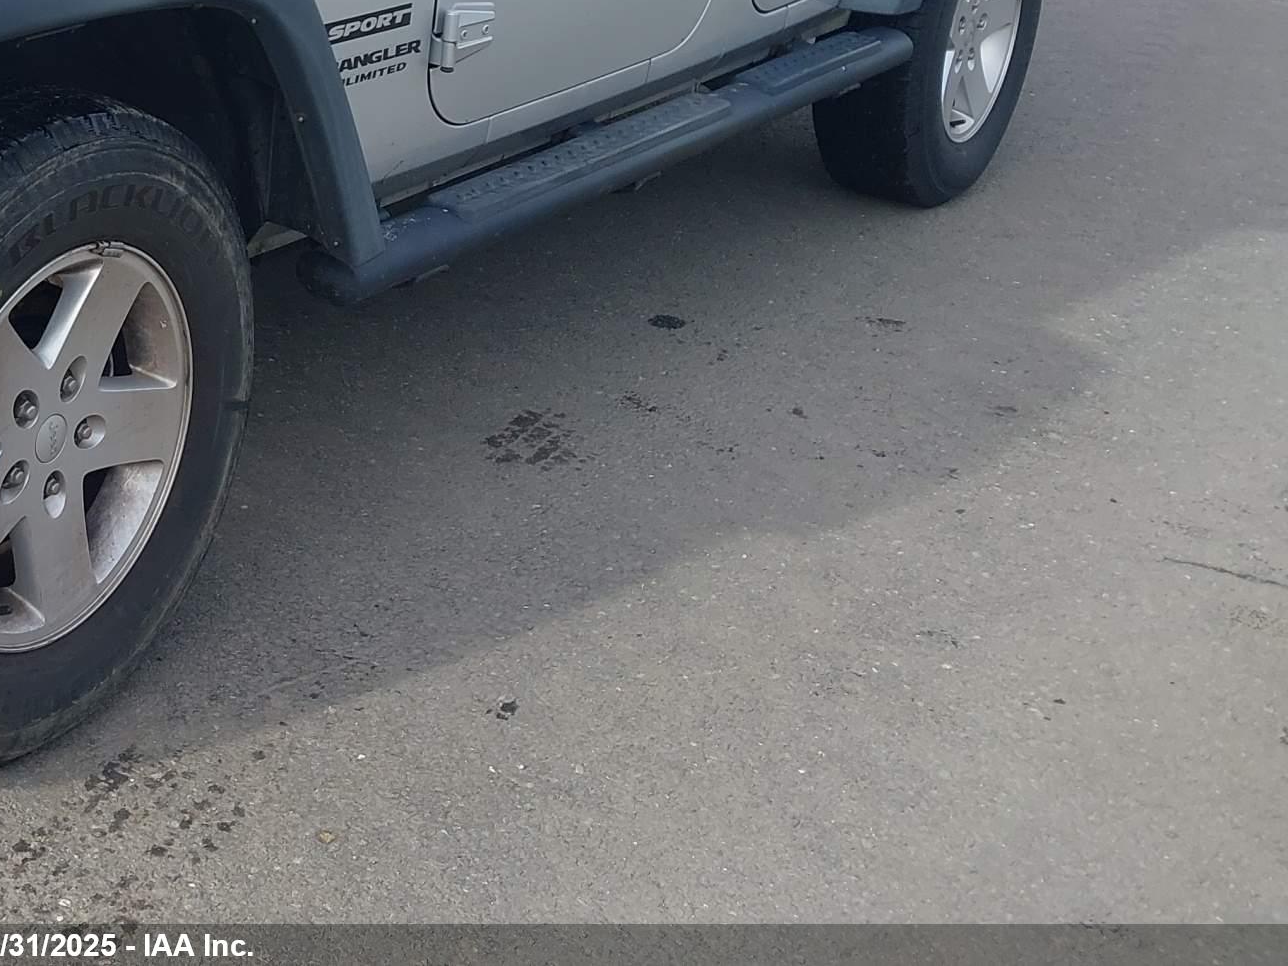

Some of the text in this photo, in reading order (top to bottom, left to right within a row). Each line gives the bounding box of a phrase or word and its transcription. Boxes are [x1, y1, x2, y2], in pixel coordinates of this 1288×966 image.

[328, 8, 412, 41] SPORT
[336, 39, 421, 72] ANGLER
[341, 61, 407, 86] LIMITED
